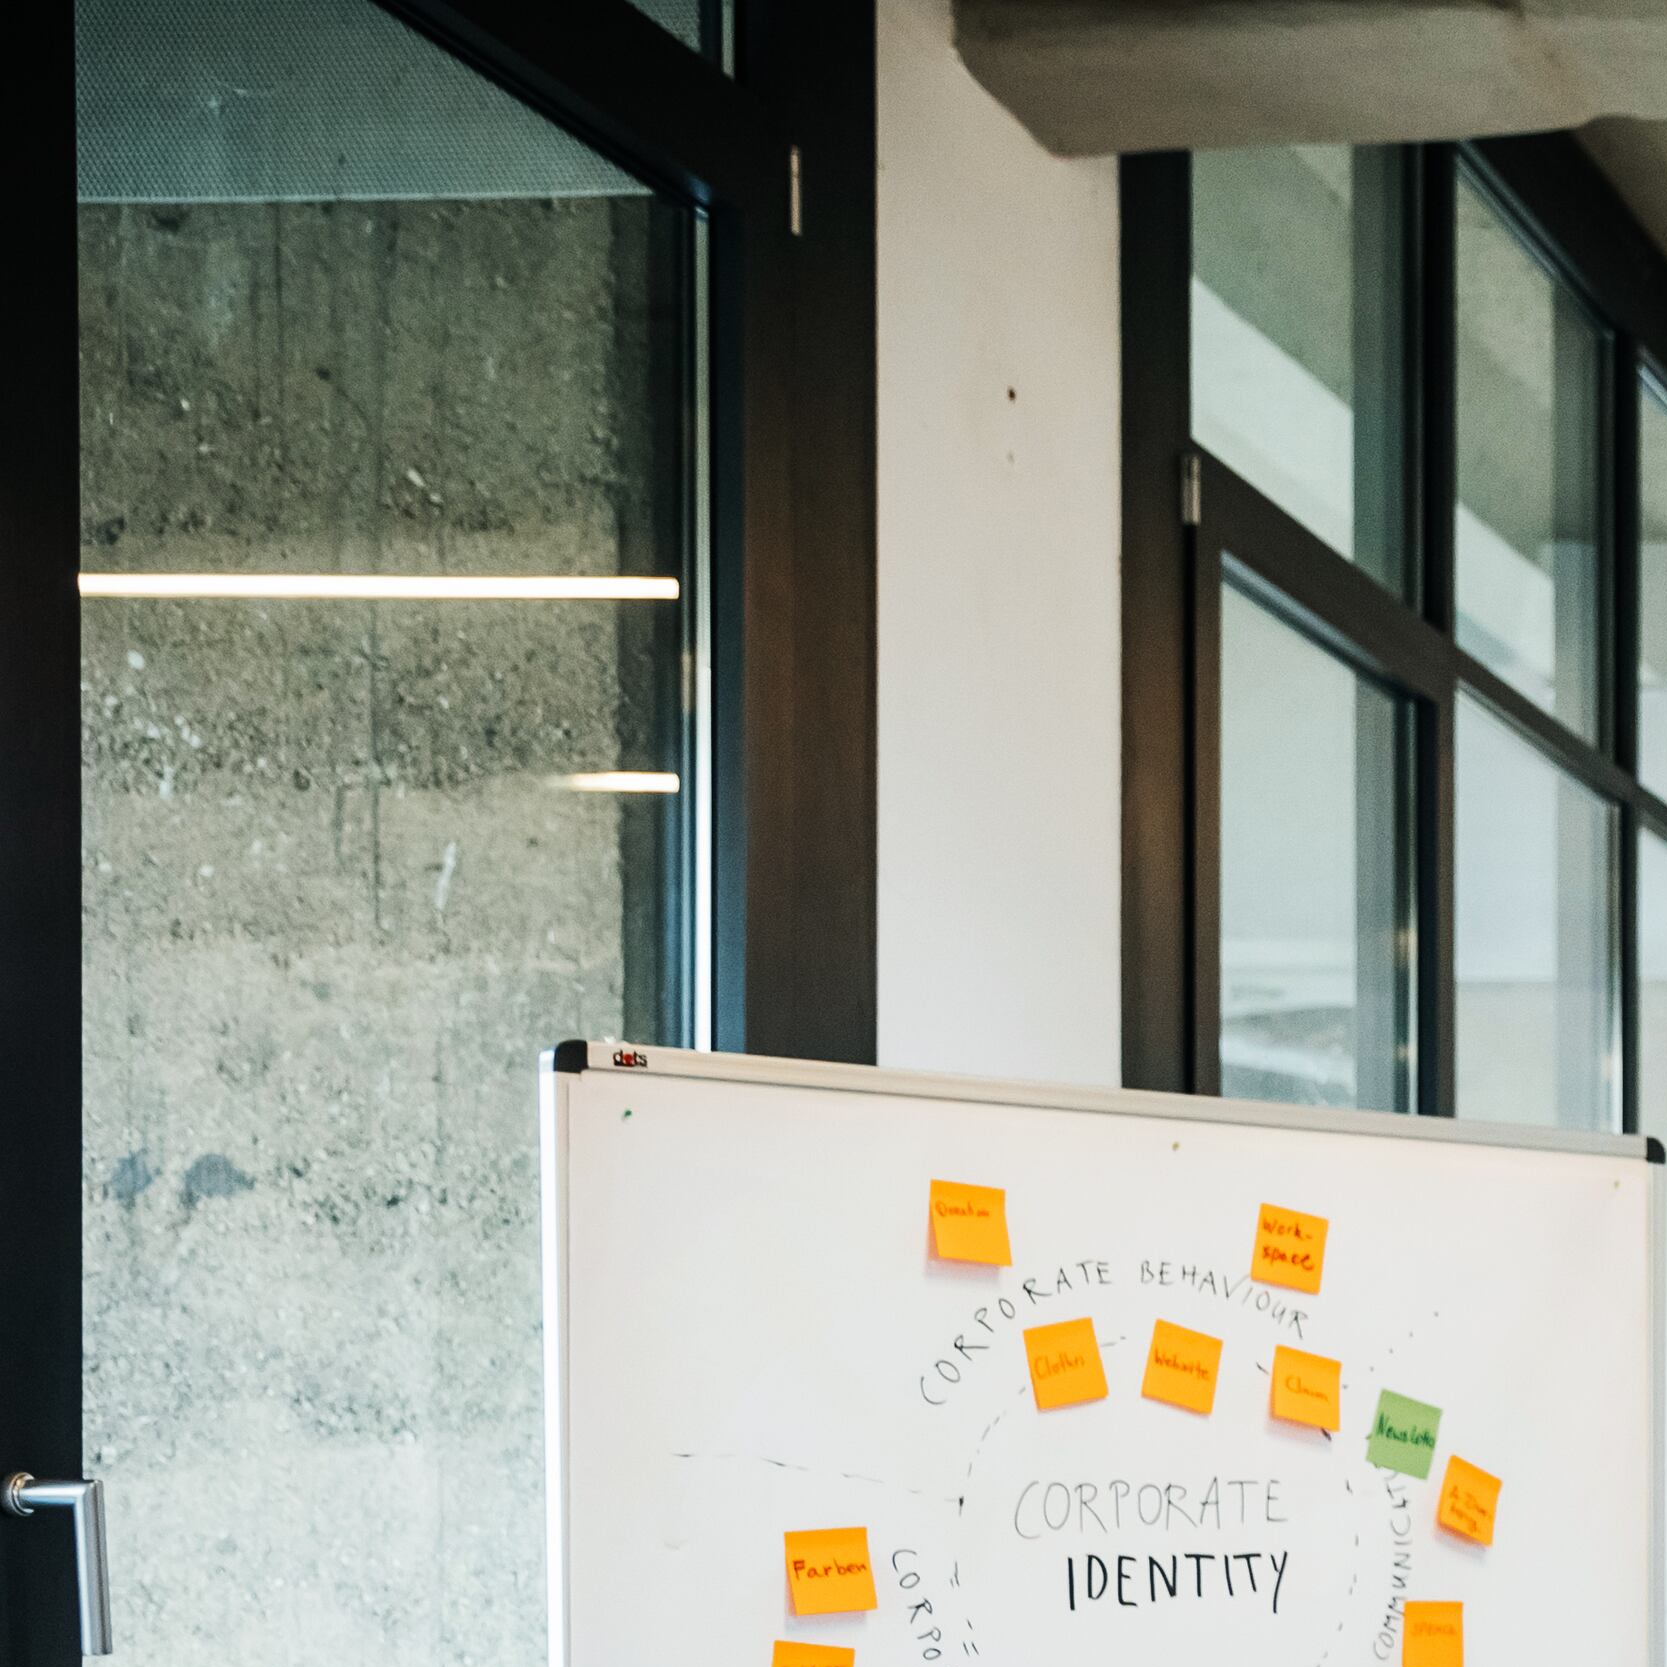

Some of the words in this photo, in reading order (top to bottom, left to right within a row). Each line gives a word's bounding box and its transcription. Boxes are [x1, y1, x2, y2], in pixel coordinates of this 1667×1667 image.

[919, 1260, 1112, 1406] CORPORATE
[1140, 1259, 1310, 1340] BEHAVIOUR
[1013, 1476, 1288, 1540] CORPORATE
[792, 1557, 867, 1580] Farben
[1067, 1550, 1288, 1614] IDENTITY
